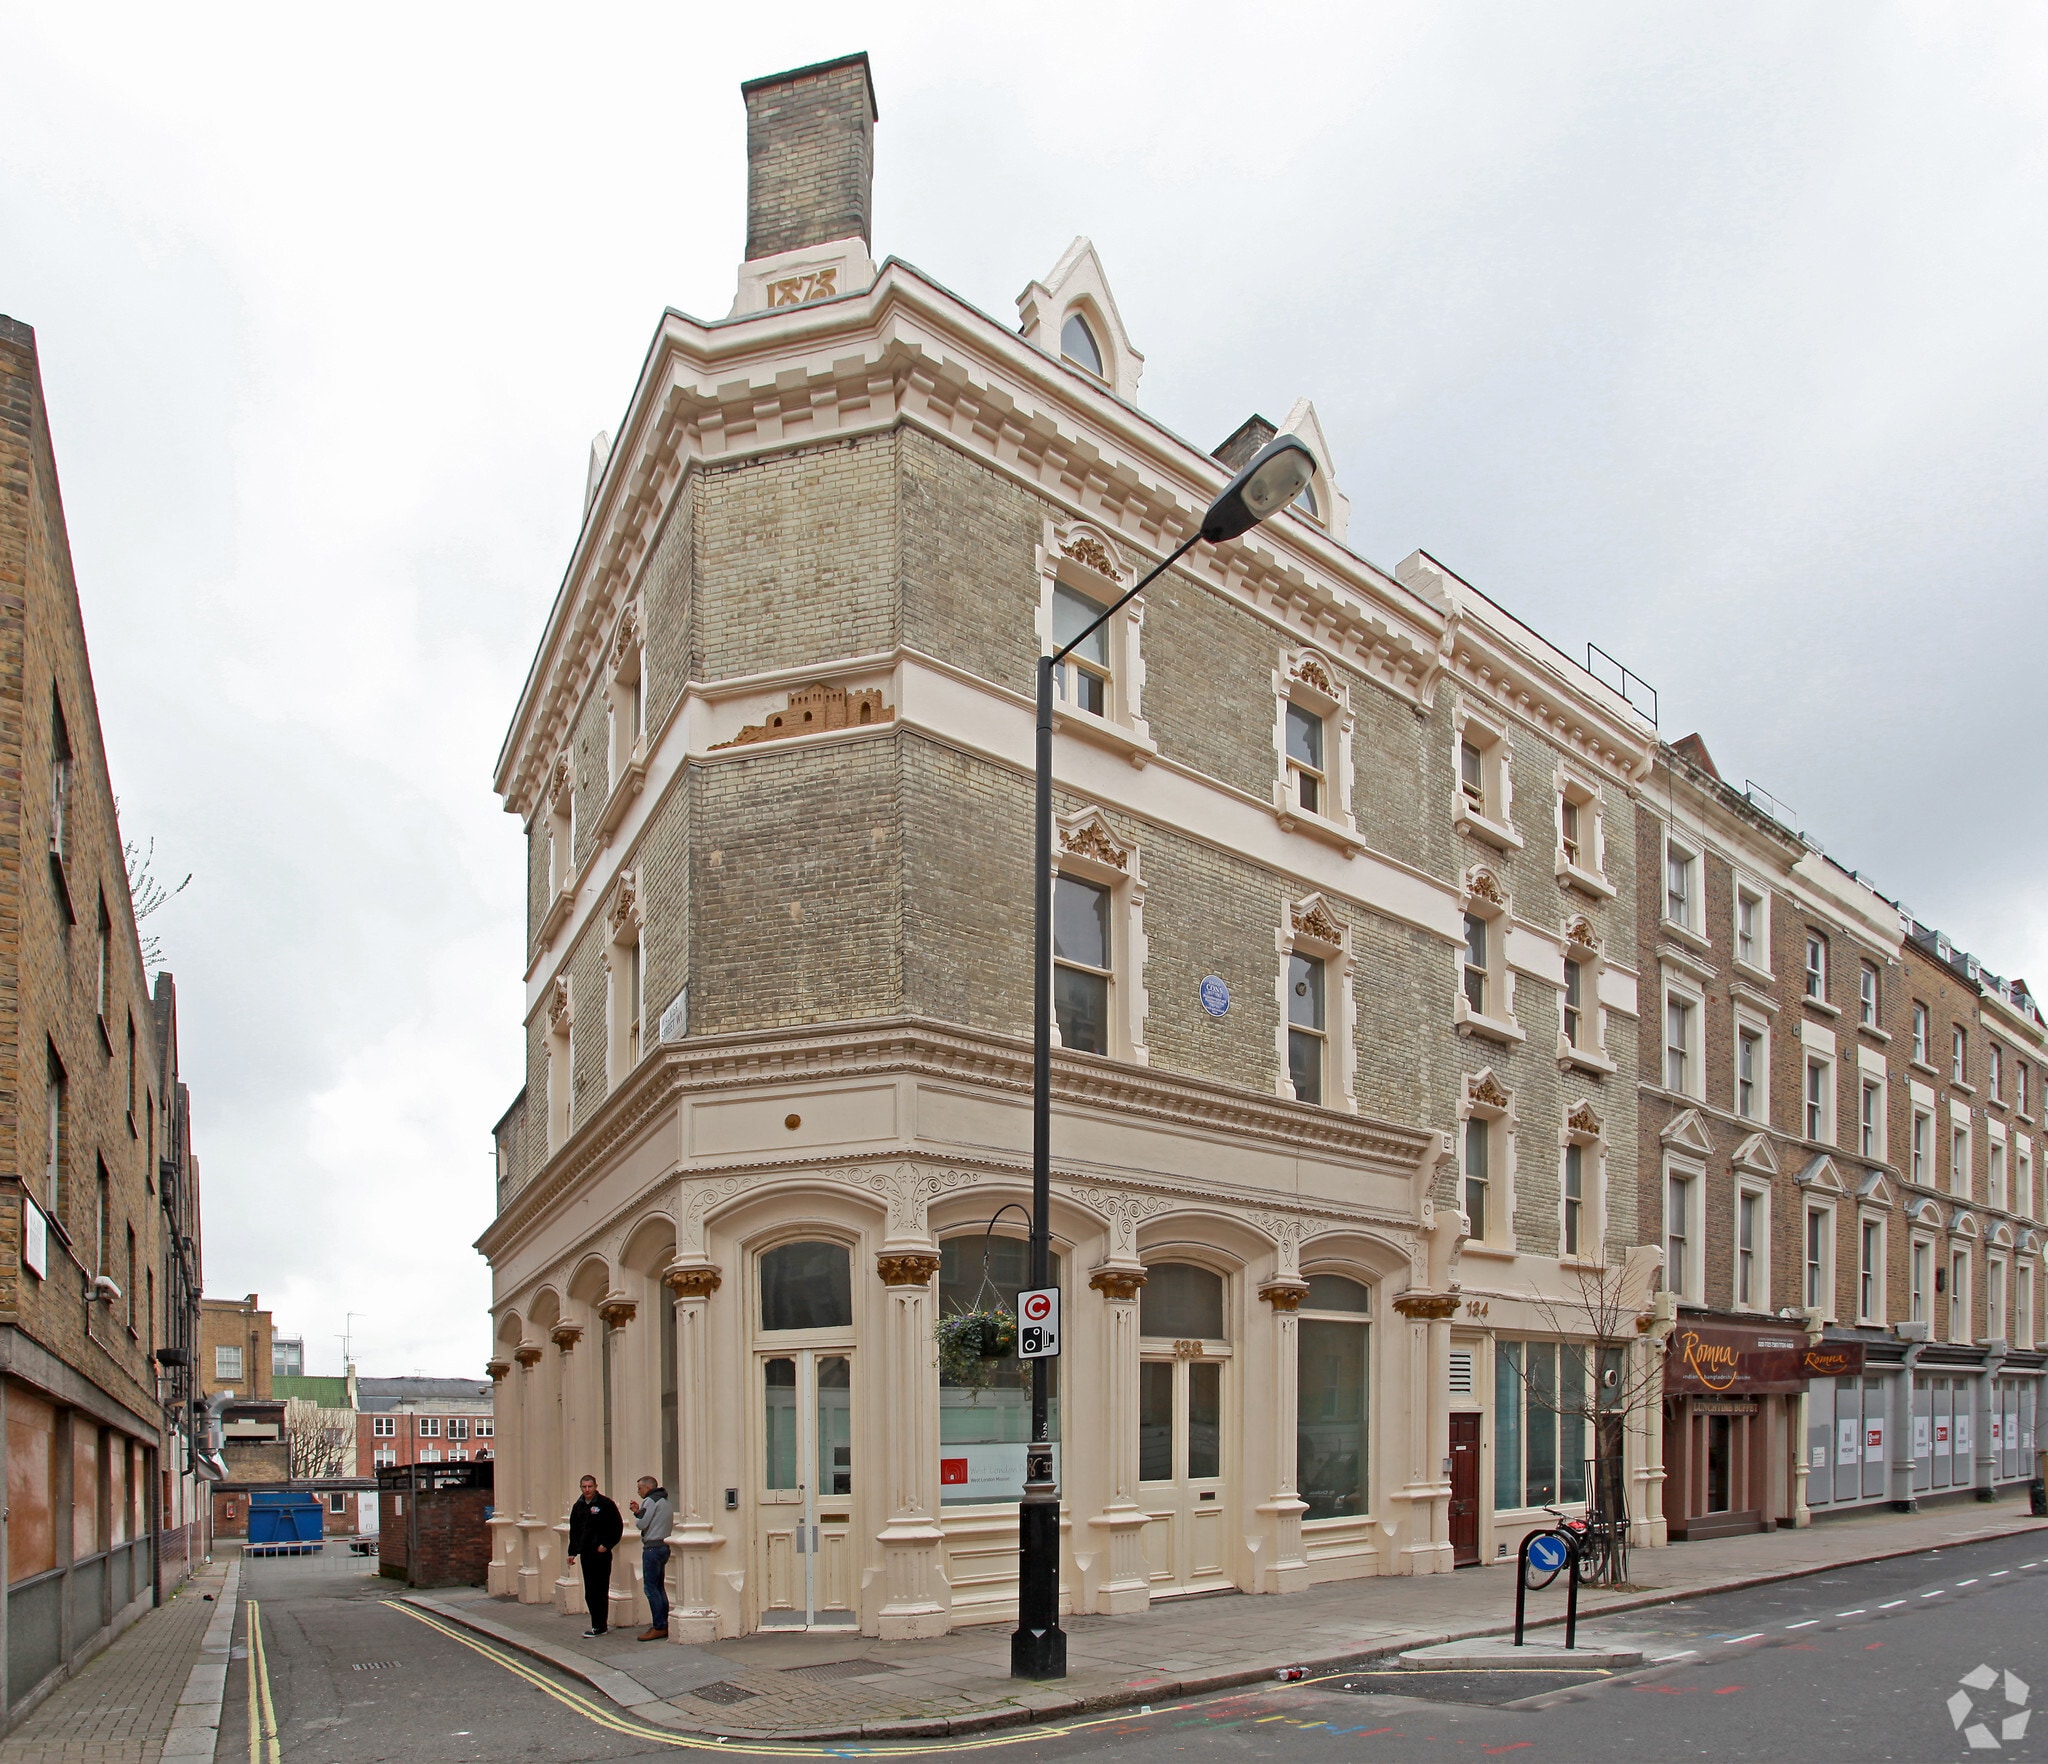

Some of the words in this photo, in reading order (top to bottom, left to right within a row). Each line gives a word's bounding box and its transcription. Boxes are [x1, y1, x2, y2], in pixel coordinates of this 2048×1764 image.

[1026, 1295, 1049, 1319] C
[1466, 1300, 1489, 1318] 134
[1681, 1331, 1739, 1390] Romna
[1803, 1352, 1848, 1374] Romna
[1734, 1403, 1758, 1412] BUFFET
